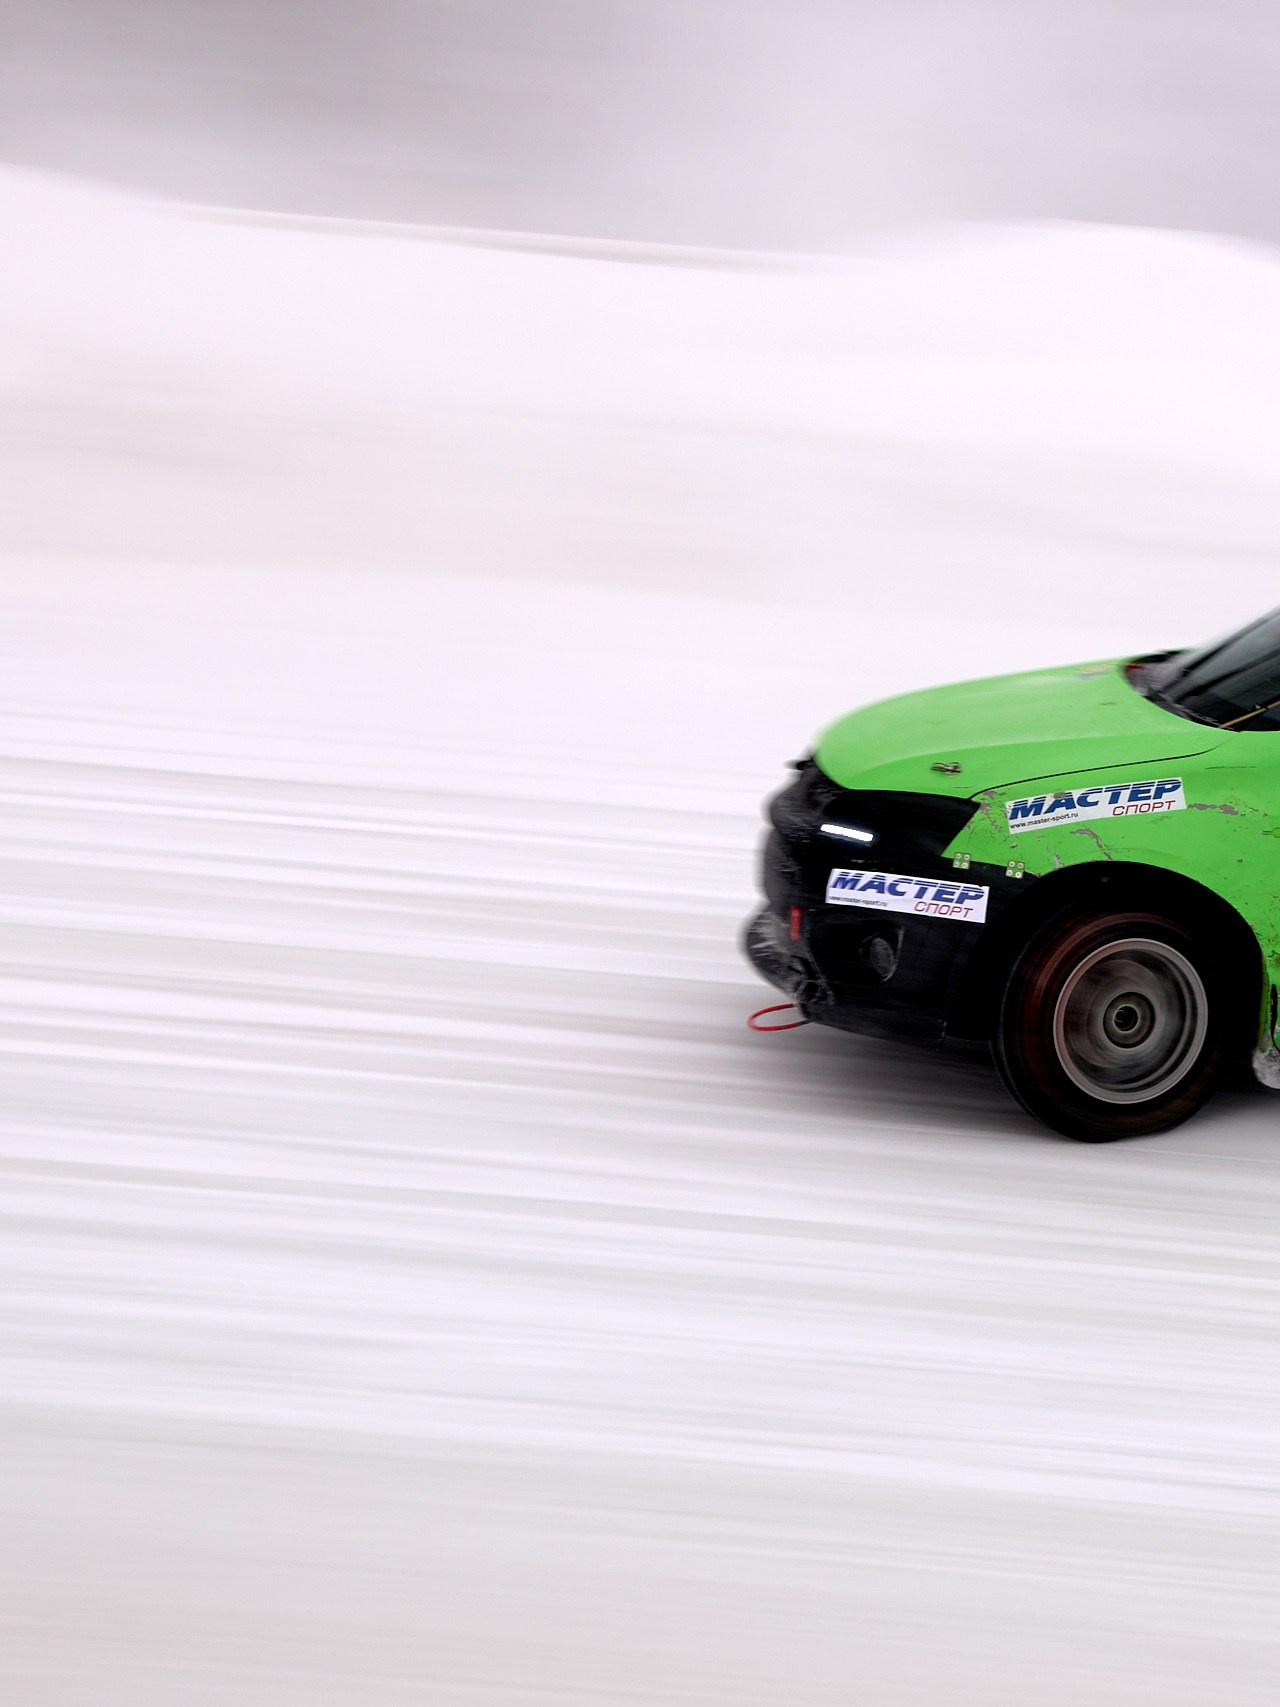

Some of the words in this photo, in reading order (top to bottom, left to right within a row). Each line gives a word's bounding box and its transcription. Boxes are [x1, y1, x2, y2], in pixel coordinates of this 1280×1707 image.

[1009, 779, 1181, 821] МАСТЕР
[1113, 800, 1176, 816] СПОРТ
[1010, 812, 1079, 829] www.master-sport.ru
[831, 871, 984, 905] МАСТЕР
[914, 902, 973, 918] СПОРТ
